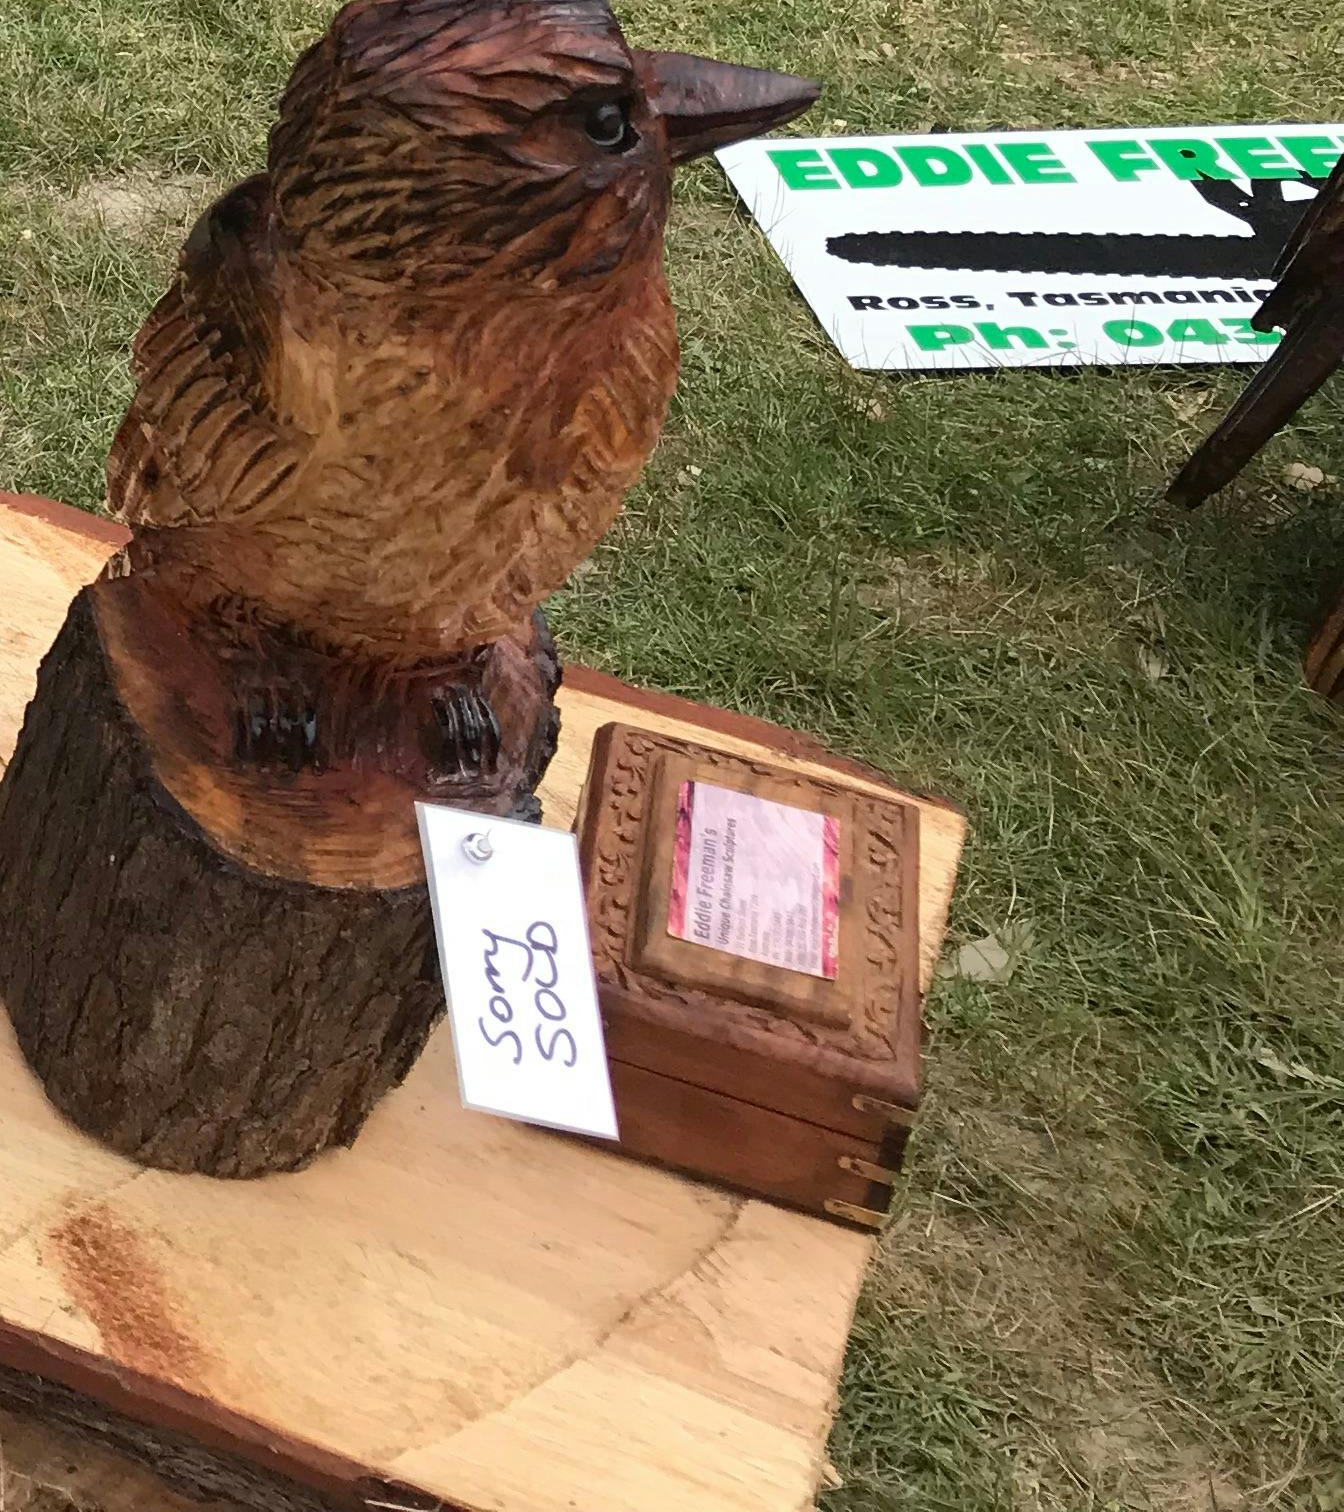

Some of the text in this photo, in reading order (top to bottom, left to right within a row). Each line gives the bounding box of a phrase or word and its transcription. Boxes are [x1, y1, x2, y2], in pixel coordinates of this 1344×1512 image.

[765, 135, 1344, 190] EDDIE FREE
[905, 322, 1077, 351] Ph:
[694, 897, 711, 940] Eddie
[479, 928, 534, 1065] Sorry
[526, 921, 577, 1067] SOLD
